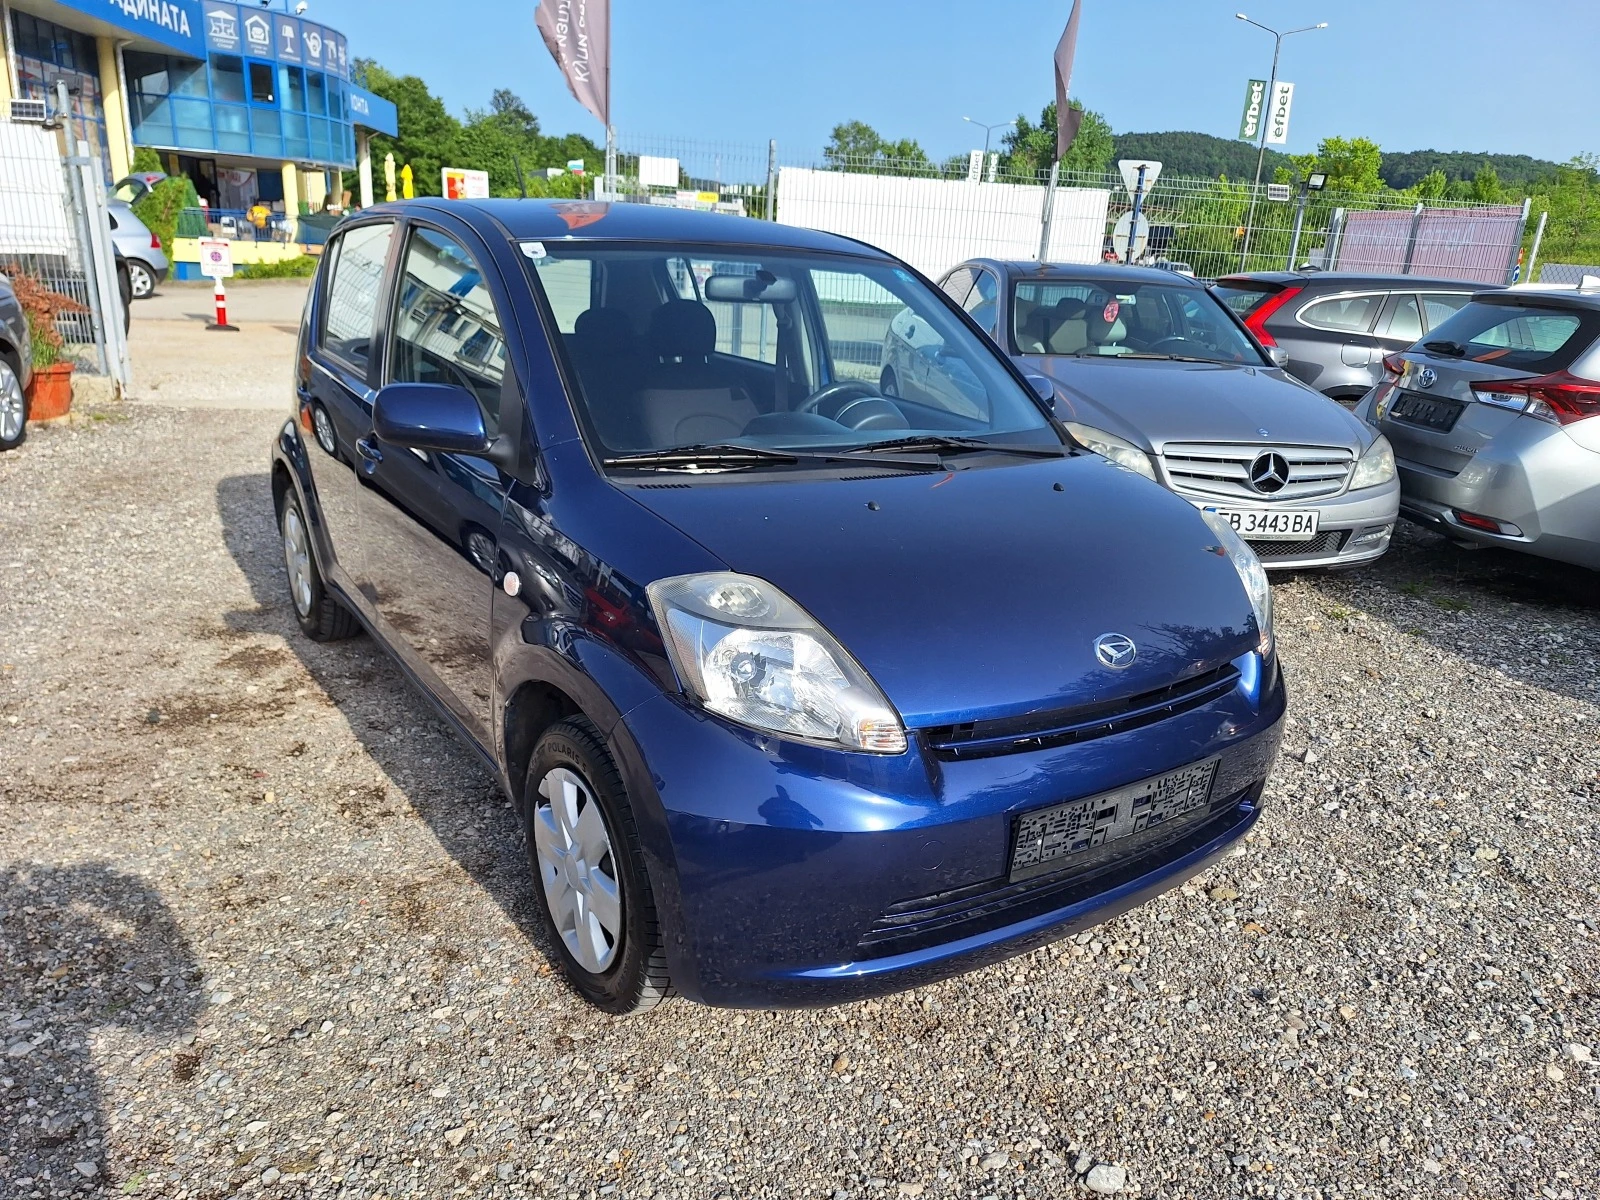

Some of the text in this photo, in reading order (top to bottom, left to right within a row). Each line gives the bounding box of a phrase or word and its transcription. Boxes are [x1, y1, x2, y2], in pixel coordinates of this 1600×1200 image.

[1244, 82, 1264, 137] efbet
[1274, 86, 1290, 138] efbet
[1245, 514, 1290, 532] 3443
[1292, 515, 1313, 533] BA
[547, 742, 580, 765] POLARIS
